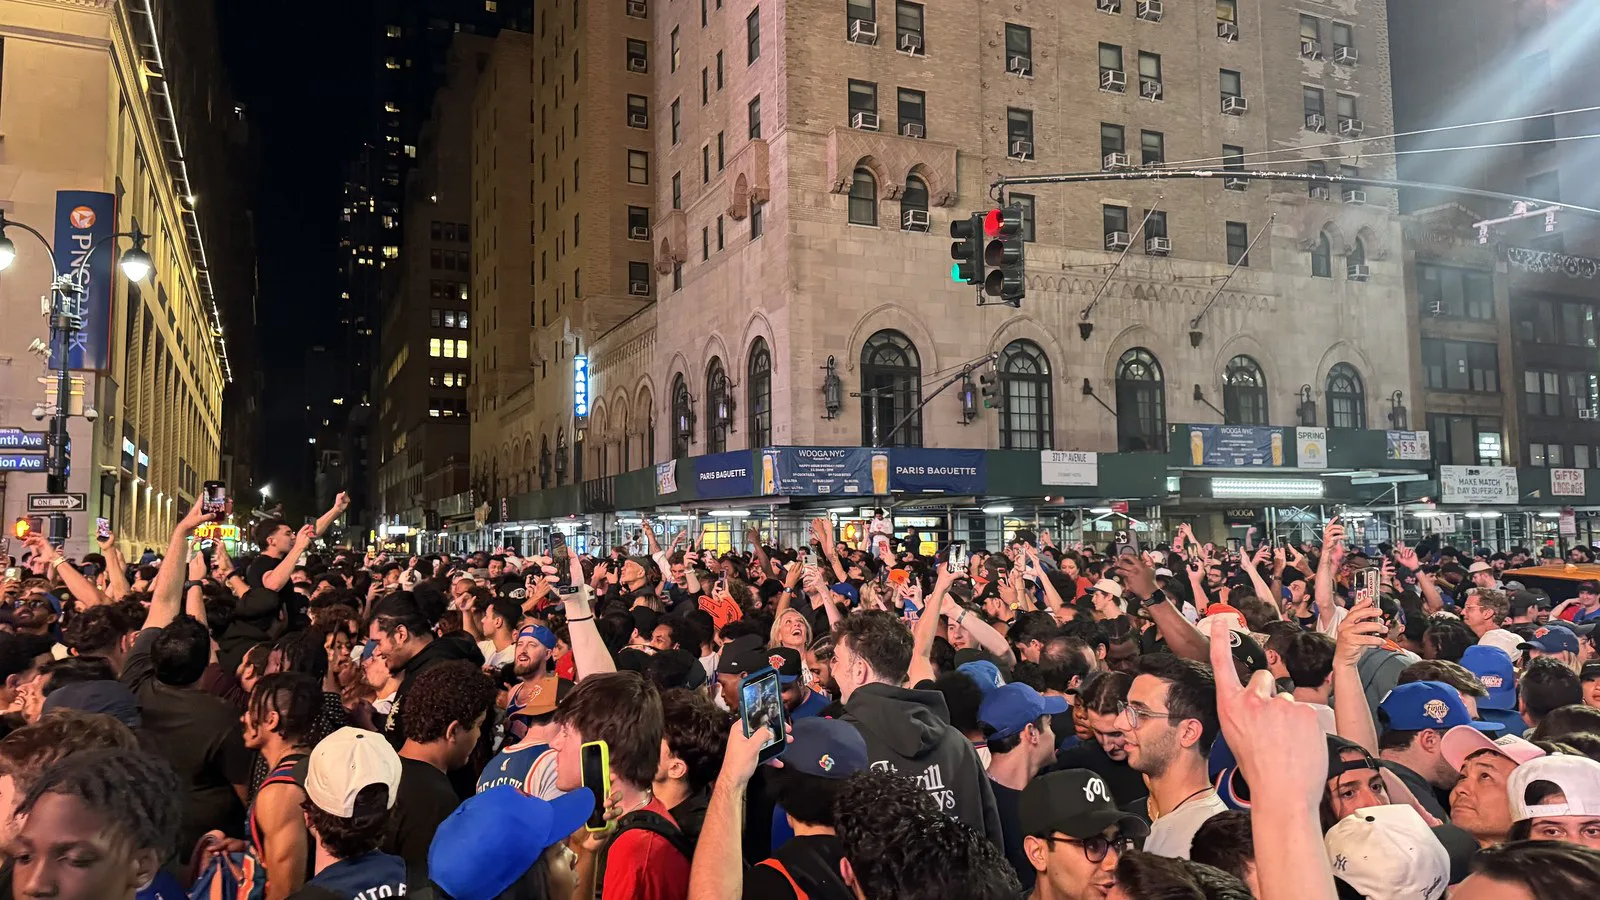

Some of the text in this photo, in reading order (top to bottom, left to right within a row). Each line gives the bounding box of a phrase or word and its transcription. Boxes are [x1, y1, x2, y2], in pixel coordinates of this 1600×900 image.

[575, 360, 585, 404] PARK
[1220, 427, 1242, 435] WOOGA
[1298, 431, 1325, 440] SPRING
[21, 435, 42, 445] Ave
[798, 450, 845, 458] WOOGA NYC
[1068, 453, 1087, 463] AVENUE
[19, 457, 41, 467] Ave
[699, 468, 746, 480] PARIS BAGUETTE
[896, 466, 977, 475] PARIS BAGUETTE
[1472, 487, 1503, 495] SUPERIOR
[1227, 509, 1255, 517] WOOGA
